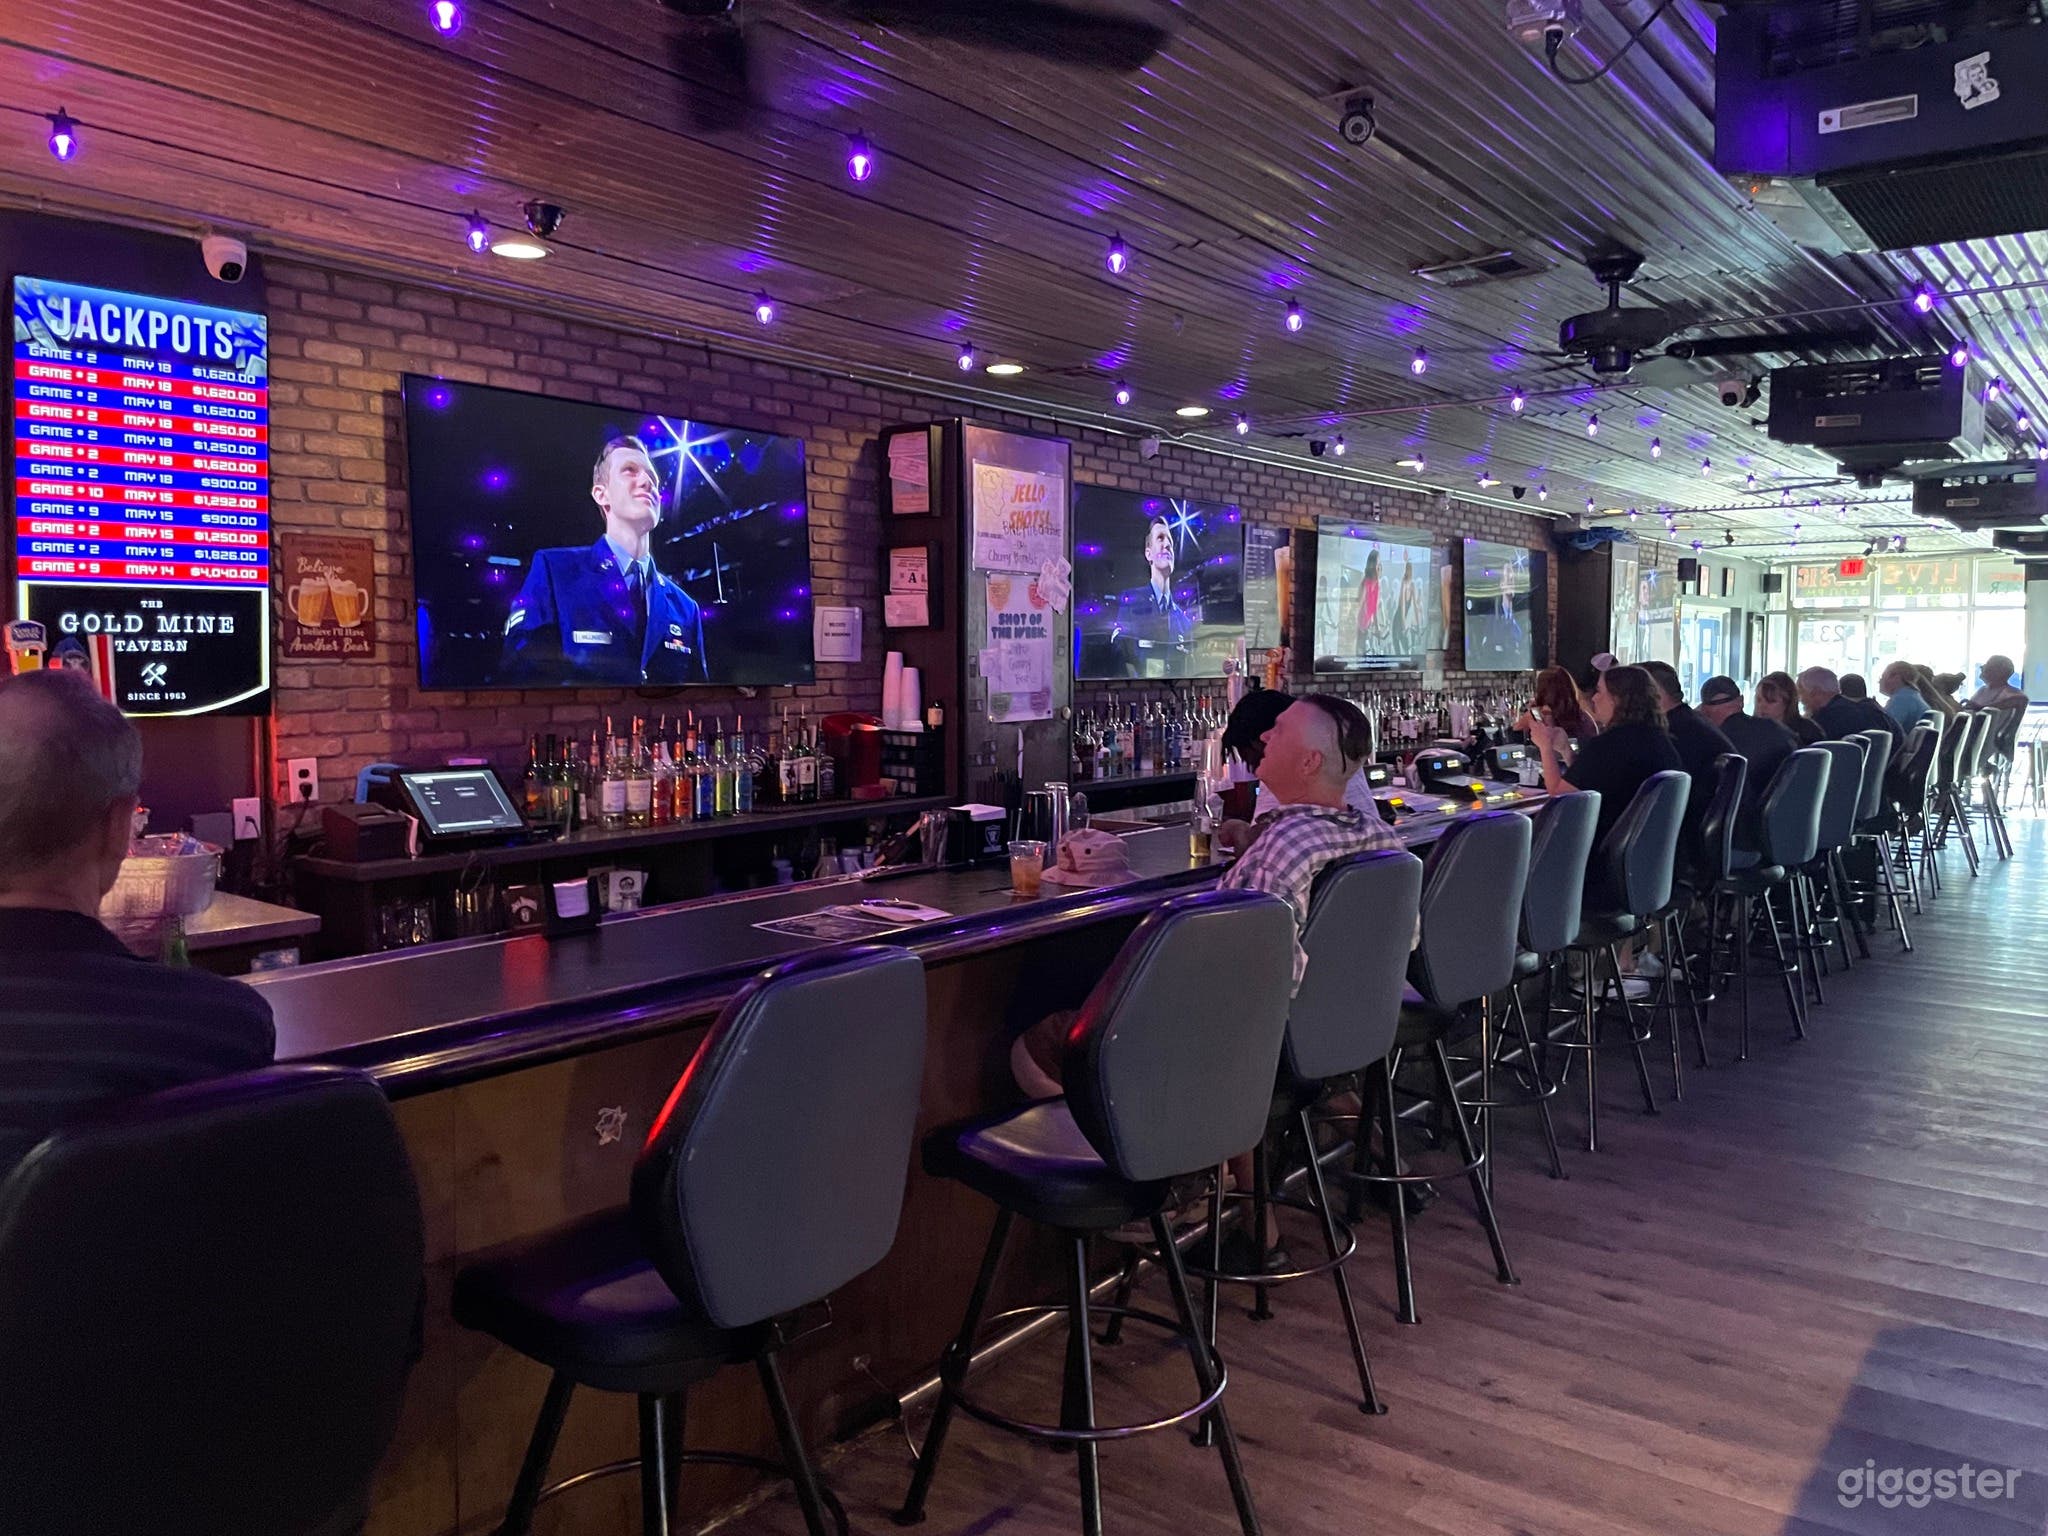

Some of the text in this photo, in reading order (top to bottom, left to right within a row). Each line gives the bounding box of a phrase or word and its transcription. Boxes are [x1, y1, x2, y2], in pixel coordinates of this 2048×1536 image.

[50, 297, 234, 359] JACKPOTS
[29, 346, 72, 360] GAME
[87, 353, 97, 363] 2
[124, 358, 154, 370] MAY
[158, 363, 171, 373] 18
[193, 368, 256, 384] $1,620.00
[29, 366, 72, 380] GAME
[87, 373, 97, 383] 2
[123, 377, 154, 389] MAY
[158, 381, 171, 391] 18
[193, 386, 256, 402] $1,620.00
[30, 386, 72, 399] GAME
[88, 392, 97, 402] 2
[124, 396, 154, 407] MAY
[159, 400, 172, 410] 18
[193, 405, 256, 419] $1,620.00
[30, 405, 72, 418] GAME
[88, 411, 98, 421] 2
[124, 415, 155, 426] MAY
[159, 419, 172, 428] 18
[193, 423, 256, 437] $1,250.00
[30, 425, 72, 437] GAME
[88, 430, 97, 440] 2
[124, 434, 155, 445] MAY
[159, 437, 172, 447] 18
[194, 441, 256, 455] $1,250.00
[30, 444, 73, 457] GAME
[88, 449, 98, 459] 2
[124, 452, 155, 464] MAY
[159, 456, 172, 465] 18
[194, 459, 256, 473] $1,620.00
[31, 464, 73, 476] GAME
[89, 469, 98, 478] 2
[125, 471, 156, 482] MAY
[160, 474, 172, 484] 18
[201, 478, 256, 490] $900.00
[31, 483, 73, 495] GAME
[89, 487, 103, 497] 10
[125, 490, 156, 500] MAY
[160, 493, 173, 502] 15
[194, 495, 257, 508] $1,292.00
[1010, 484, 1045, 503] JELLO
[31, 503, 73, 514] GAME
[89, 507, 99, 516] 9
[126, 509, 156, 519] MAY
[160, 511, 173, 520] 15
[202, 514, 257, 526] $900.00
[31, 522, 74, 534] GAME
[89, 525, 99, 535] 2
[125, 527, 156, 538] MAY
[160, 529, 173, 539] 15
[194, 532, 257, 544] $1,250.00
[32, 542, 74, 553] GAME
[90, 545, 99, 554] 2
[126, 546, 156, 556] MAY
[161, 548, 173, 557] 15
[32, 561, 75, 572] GAME
[90, 563, 100, 573] 9
[126, 565, 156, 575] MAY
[161, 566, 174, 575] 14
[191, 567, 257, 579] $4,040.00
[297, 557, 344, 574] Believe
[140, 600, 164, 608] THE
[60, 613, 144, 633] GOLD
[157, 614, 235, 634] MINE
[998, 613, 1042, 625] SHOT OF
[991, 626, 1012, 639] THE
[114, 640, 188, 652] TAVERN
[290, 636, 370, 655] Another Beer
[127, 692, 161, 701] SINCE
